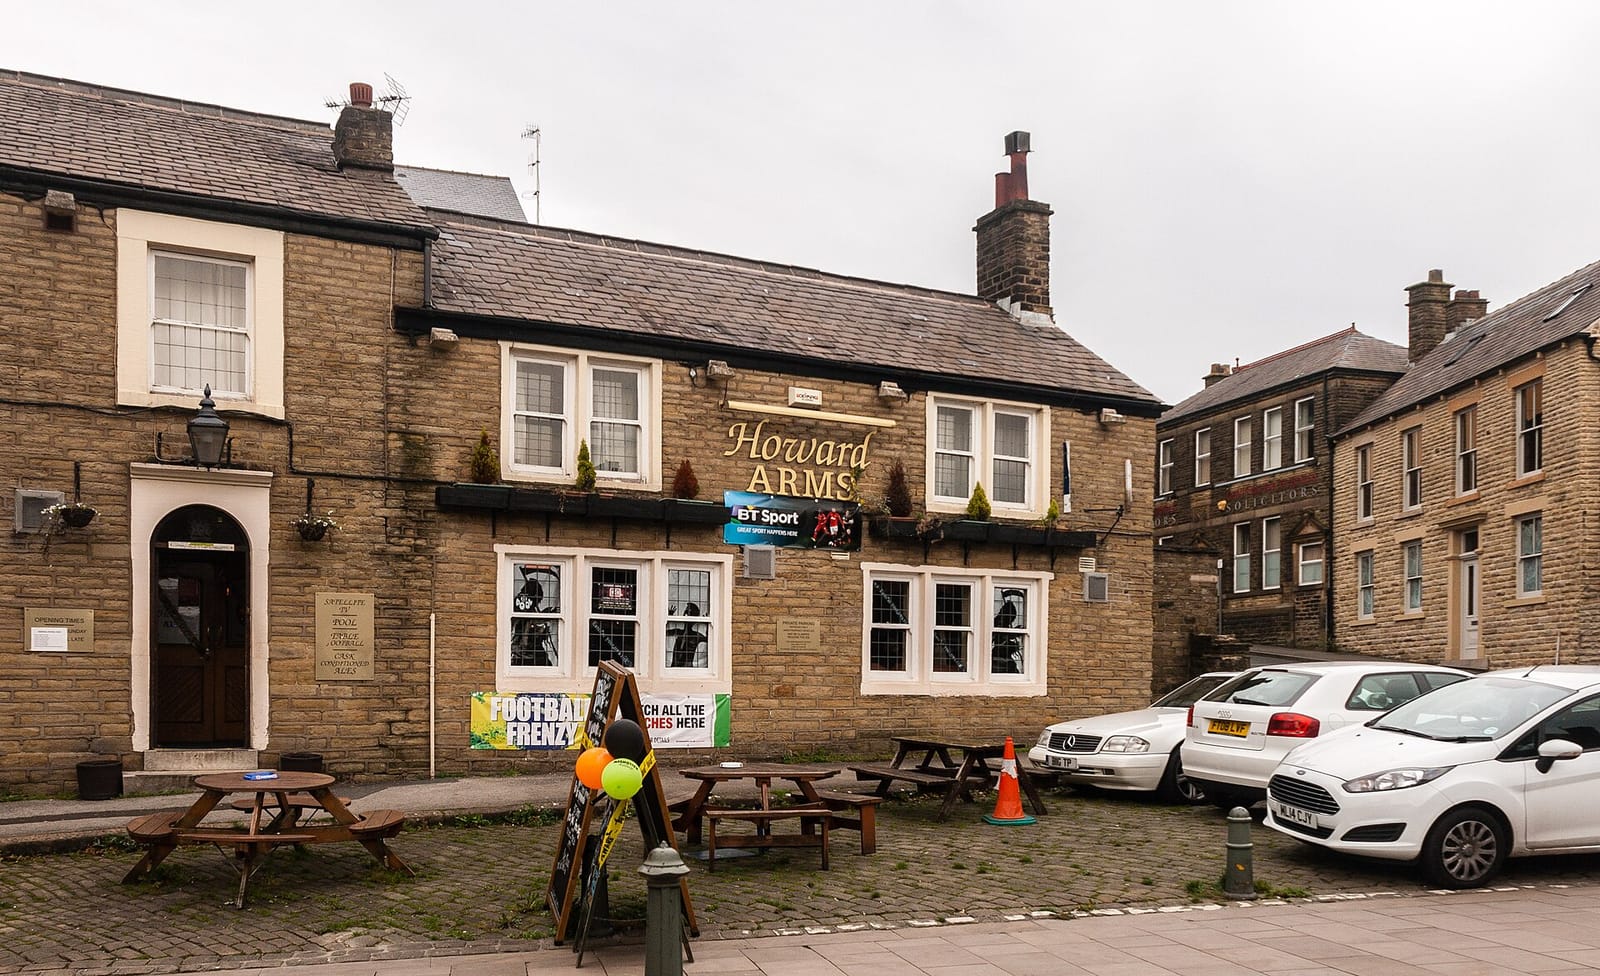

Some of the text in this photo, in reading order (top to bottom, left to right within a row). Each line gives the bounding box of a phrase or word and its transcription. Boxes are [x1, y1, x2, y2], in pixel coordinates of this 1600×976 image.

[724, 419, 877, 470] Howard
[746, 464, 856, 501] ARMS
[1226, 487, 1318, 513] SOLICITORS
[737, 508, 799, 525] BT Sport
[323, 598, 366, 606] SATELLITE
[334, 667, 357, 675] ALES
[662, 704, 682, 716] ALL
[684, 704, 705, 716] THE
[676, 717, 706, 728] HERE
[507, 722, 579, 746] FRENZY
[1279, 804, 1312, 824] ML14 CJY
